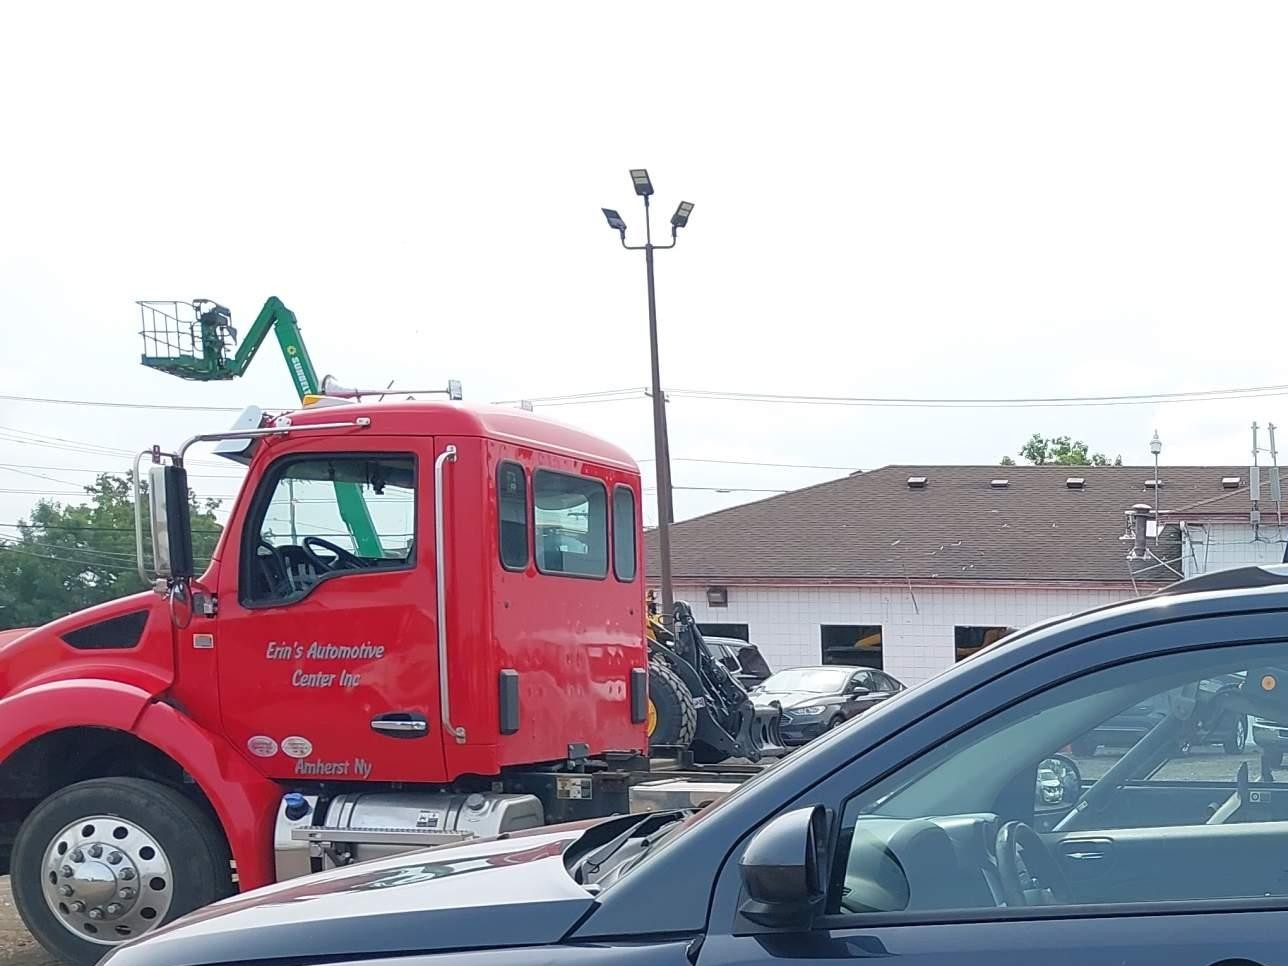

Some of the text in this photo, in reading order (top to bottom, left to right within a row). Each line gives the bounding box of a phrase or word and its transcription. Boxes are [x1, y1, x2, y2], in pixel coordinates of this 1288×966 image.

[266, 641, 385, 659] Erin's Automotive
[292, 669, 361, 688] Center Inc
[294, 758, 372, 779] Amherst Ny
